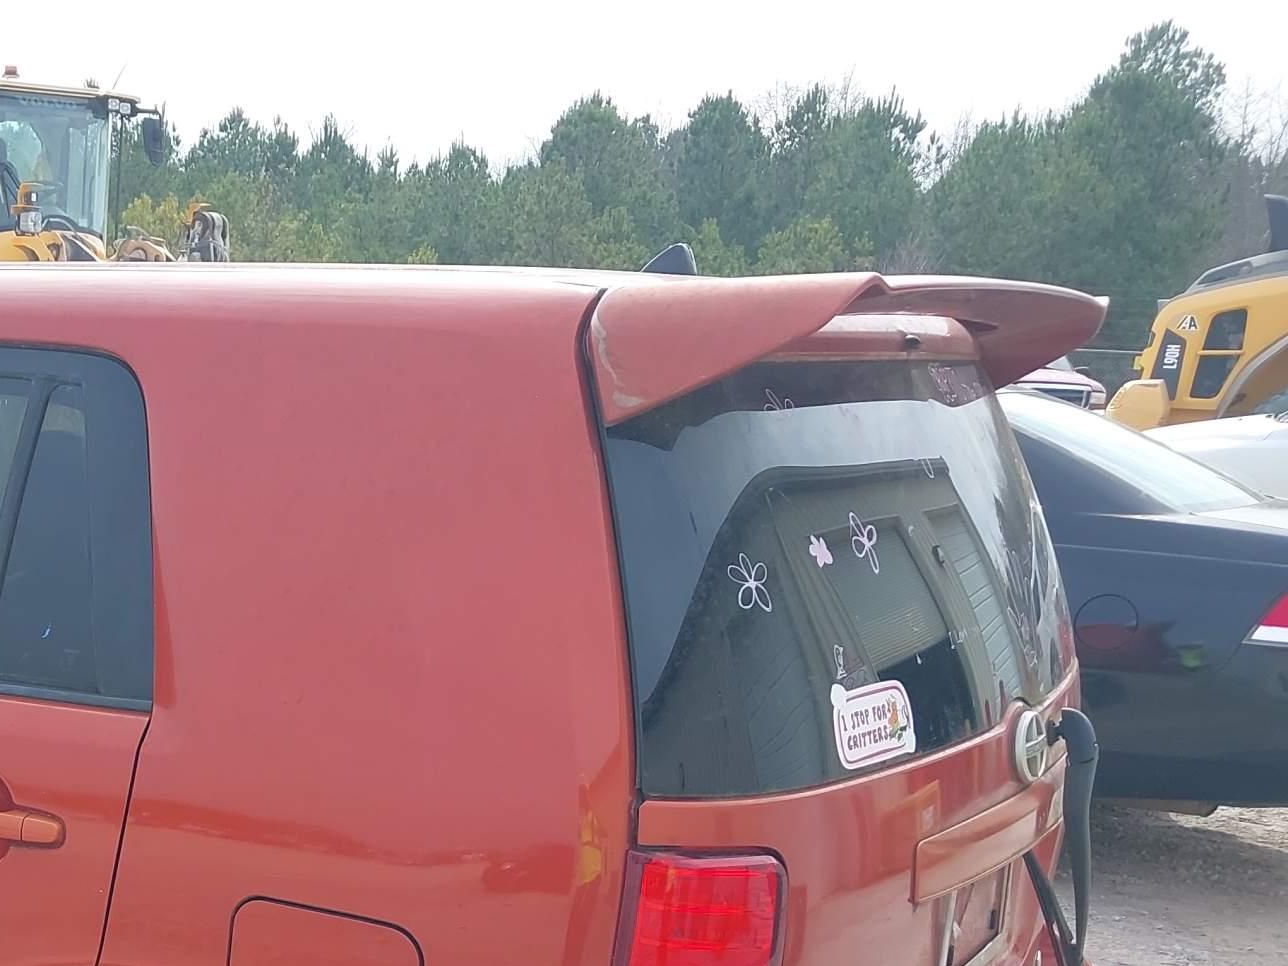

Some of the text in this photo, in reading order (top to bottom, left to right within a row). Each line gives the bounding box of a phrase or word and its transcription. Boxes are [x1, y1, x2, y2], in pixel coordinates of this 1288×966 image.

[1162, 344, 1182, 369] L90H
[841, 703, 888, 732] I STOP FOR
[847, 725, 889, 751] CRITTERS
